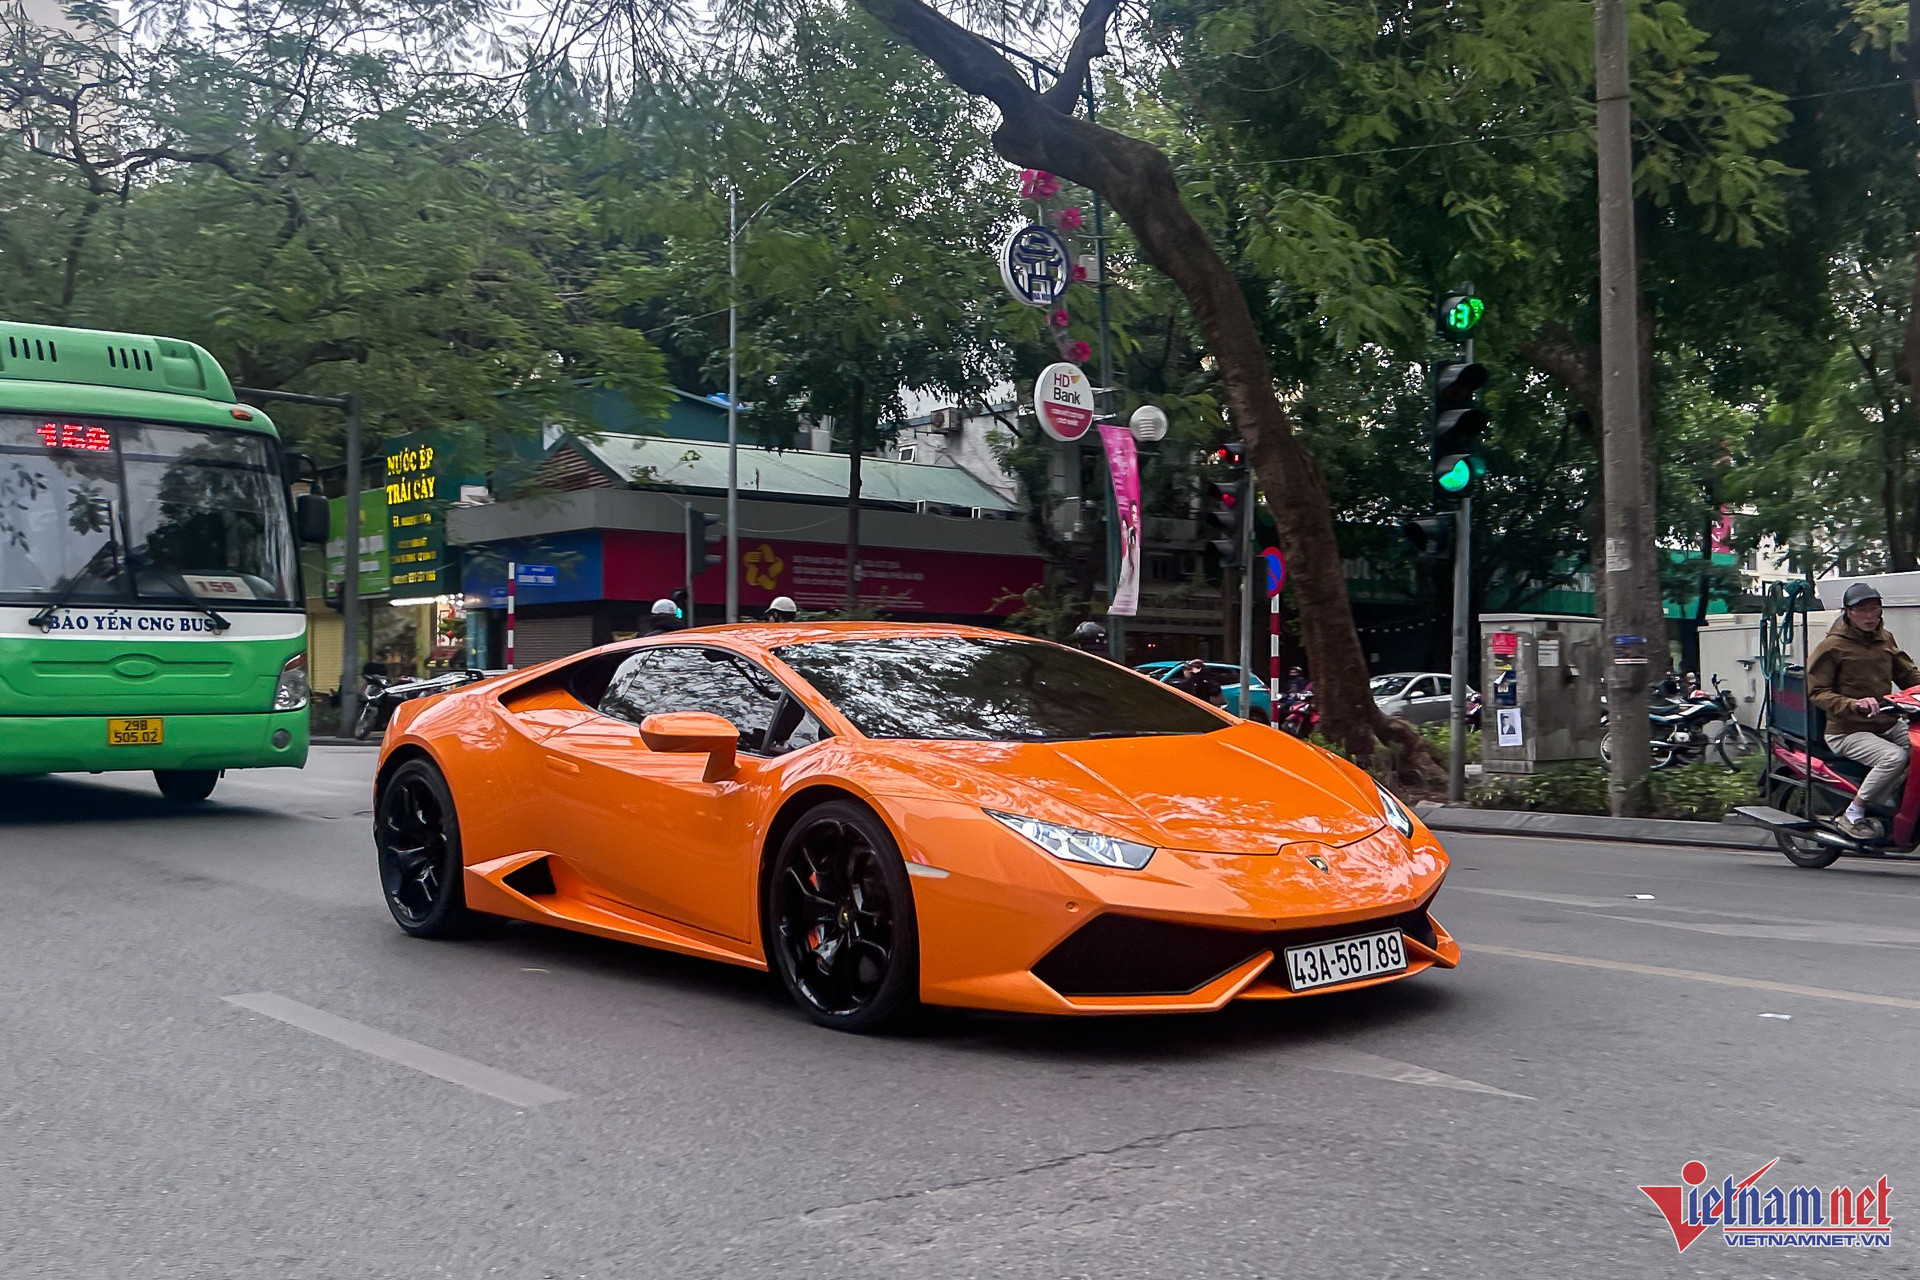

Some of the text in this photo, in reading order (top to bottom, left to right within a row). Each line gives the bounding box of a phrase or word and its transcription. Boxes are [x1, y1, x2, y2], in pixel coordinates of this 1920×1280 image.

[1054, 373, 1070, 387] HD
[1054, 387, 1080, 405] Bank
[386, 476, 411, 505] TRÁI
[195, 580, 238, 593] 159
[50, 608, 216, 632] BẢO YẾN CNG BUS
[124, 719, 148, 731] 29B
[1294, 934, 1402, 985] 43A-567.89
